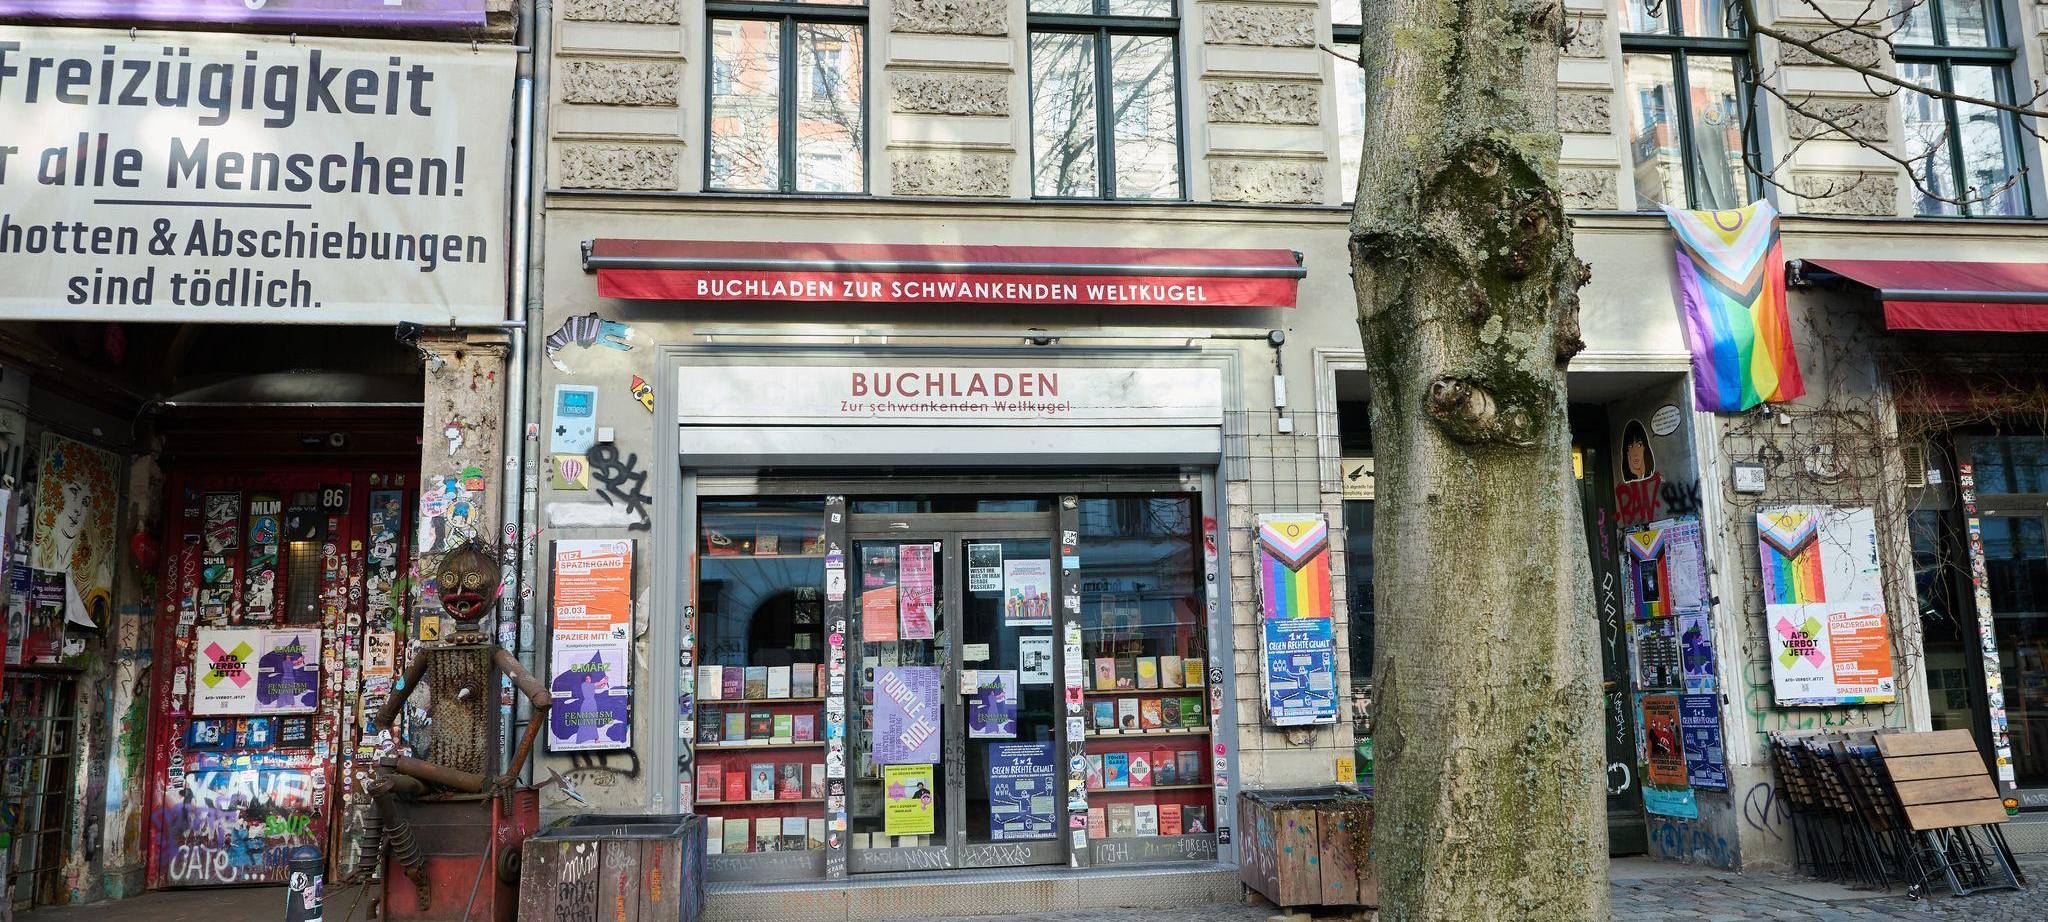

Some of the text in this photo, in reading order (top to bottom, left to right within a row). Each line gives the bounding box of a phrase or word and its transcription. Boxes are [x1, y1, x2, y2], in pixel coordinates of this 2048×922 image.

[0, 41, 433, 128] Freizügigkeit
[0, 132, 465, 197] r alle Menschen!
[0, 214, 487, 272] hotten & Abschiebungen
[67, 267, 322, 308] sind tödlich.
[697, 279, 1207, 302] BUCHLADEN ZUR SCHWANKENDEN WELTKUGEL
[852, 372, 1059, 397] BUCHLADEN
[840, 399, 1071, 415] Zur schwankenden Weltkugel
[323, 489, 344, 508] 86
[252, 501, 281, 515] MLM
[560, 552, 580, 561] KIEZ
[561, 560, 621, 569] SPAZIERGANG
[559, 607, 585, 615] 20.03.
[1831, 619, 1880, 629] SPAZIERGANG
[556, 633, 608, 641] SPAZIER MIT!
[1268, 640, 1330, 651] GEGEN RECHTE GEWALT
[1782, 639, 1818, 648] VERBOT
[1788, 648, 1814, 656] JETZT
[219, 655, 238, 663] AFD
[209, 662, 247, 670] VERBOT
[214, 670, 242, 678] JETZT
[877, 670, 926, 719] PURPLE
[900, 714, 937, 753] RIDE
[992, 764, 1053, 775] GEGEN RECHTE GEWALT
